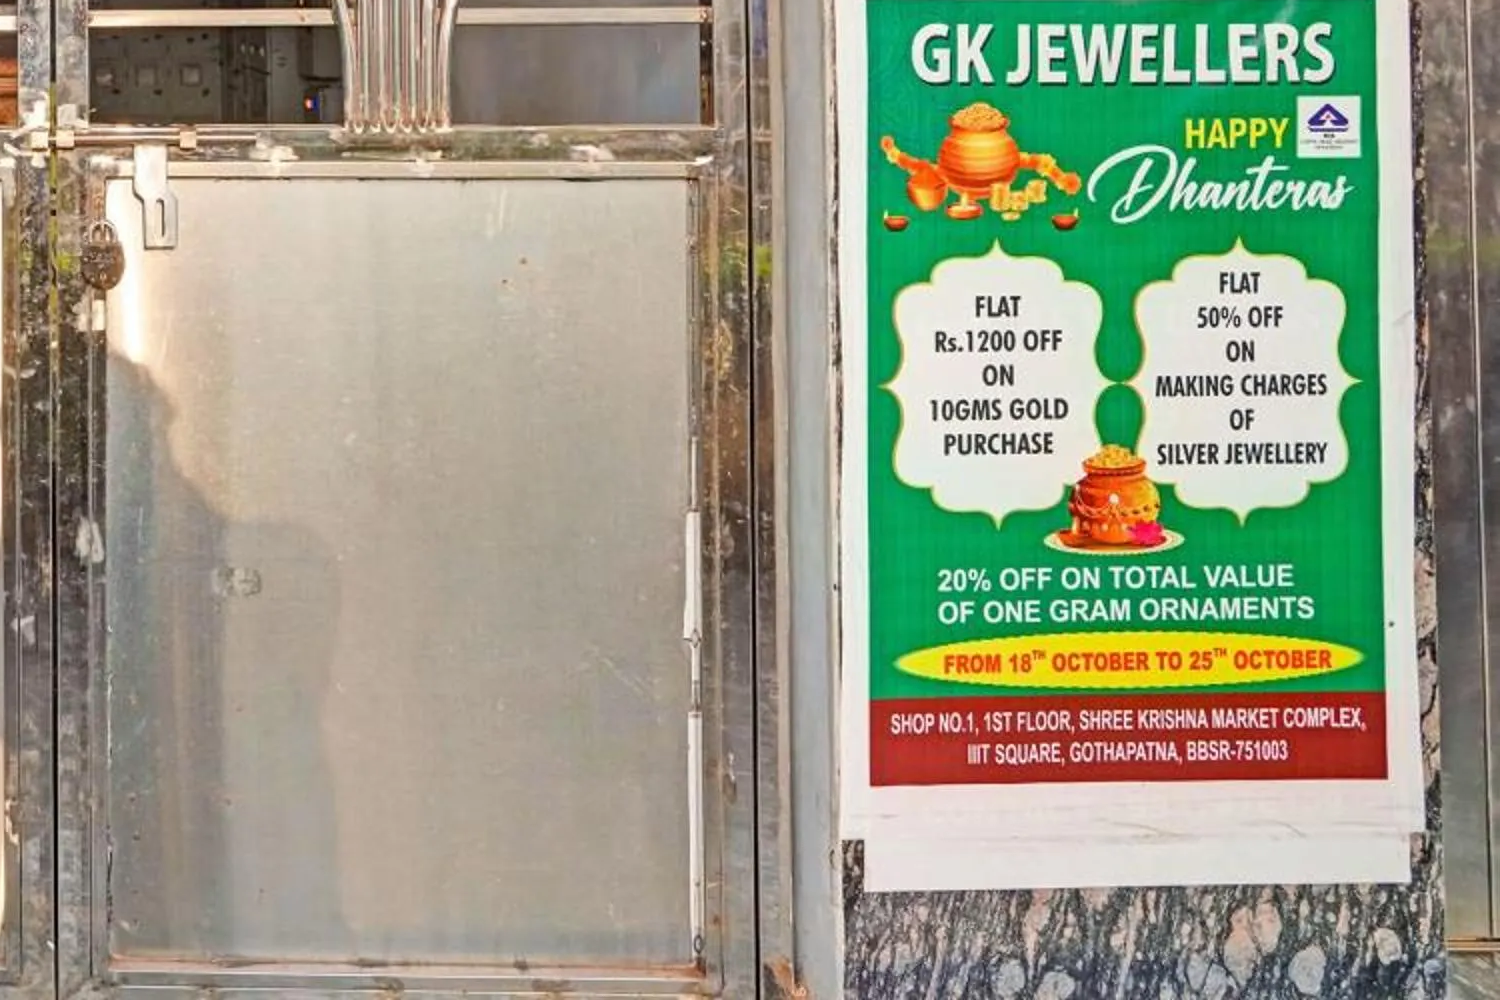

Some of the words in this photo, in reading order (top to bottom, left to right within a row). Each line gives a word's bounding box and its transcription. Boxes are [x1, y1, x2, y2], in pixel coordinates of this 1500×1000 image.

[910, 22, 995, 85] GK
[1005, 21, 1338, 85] JEWELLERS
[1184, 117, 1290, 150] HAPPY
[1086, 143, 1356, 224] Dhanteras
[1219, 272, 1261, 295] FLAT
[975, 296, 1022, 318] FLAT
[1197, 306, 1241, 329] 50%
[1249, 305, 1284, 328] OFF
[934, 330, 1016, 354] Rs.1200
[1023, 330, 1064, 352] OFF
[1226, 340, 1256, 363] ON
[982, 364, 1015, 387] ON
[1155, 375, 1235, 398] MAKING
[1241, 373, 1328, 397] CHARGES
[931, 398, 1002, 422] 10GMS
[1010, 397, 1069, 421] GOLD
[1229, 409, 1255, 432] OF
[943, 432, 1054, 456] PURCHASE
[1156, 443, 1220, 466] SILVER
[1224, 441, 1328, 465] JEWELLERY
[937, 568, 992, 592] 20%
[999, 568, 1053, 591] OFF
[1061, 567, 1101, 590] ON
[1109, 565, 1197, 589] TOTAL
[1204, 564, 1295, 588] VALUE
[938, 601, 975, 624] OF
[983, 600, 1041, 624] ONE
[1049, 599, 1132, 622] GRAM
[1139, 596, 1315, 621] ORNAMENTS
[944, 654, 1001, 674] FROM
[1052, 651, 1149, 673] OCTOBER
[1156, 651, 1183, 670] TO
[1233, 649, 1333, 669] OCTOBER
[890, 713, 935, 734] SHOP
[938, 712, 980, 735] NO.1,
[984, 711, 1013, 731] 1ST
[1017, 711, 1076, 734] FLOOR,
[1079, 710, 1134, 730] SHREE
[1137, 709, 1207, 729] KRISHNA
[1211, 708, 1279, 728] MARKET
[1283, 707, 1367, 731] COMPLEX,
[995, 743, 1066, 766] SQUARE,
[1069, 742, 1184, 765] GOTHAPATNA,
[1187, 740, 1289, 761] BBSR-751003
